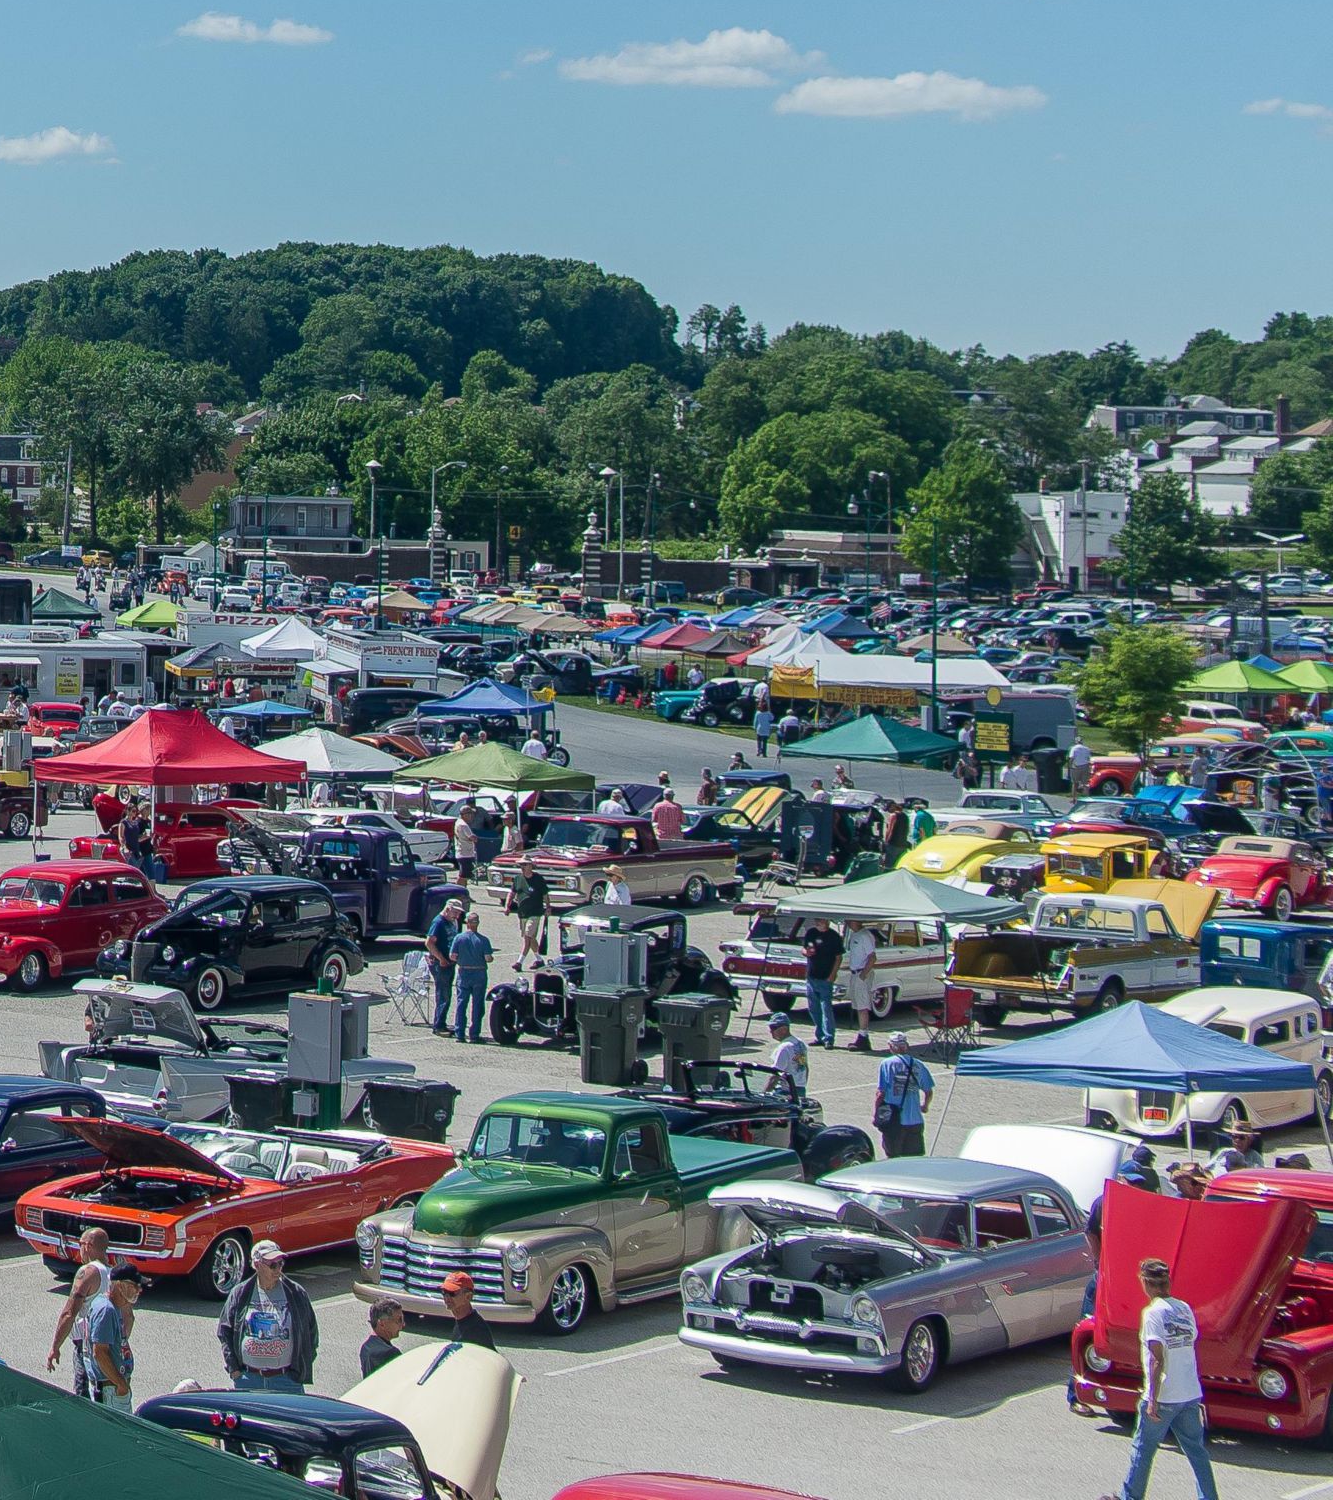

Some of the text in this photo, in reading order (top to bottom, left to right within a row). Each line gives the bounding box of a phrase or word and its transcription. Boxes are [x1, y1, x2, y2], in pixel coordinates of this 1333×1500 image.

[214, 615, 279, 626] PIZZA
[383, 645, 413, 656] FRENCH
[415, 646, 438, 658] FRIES
